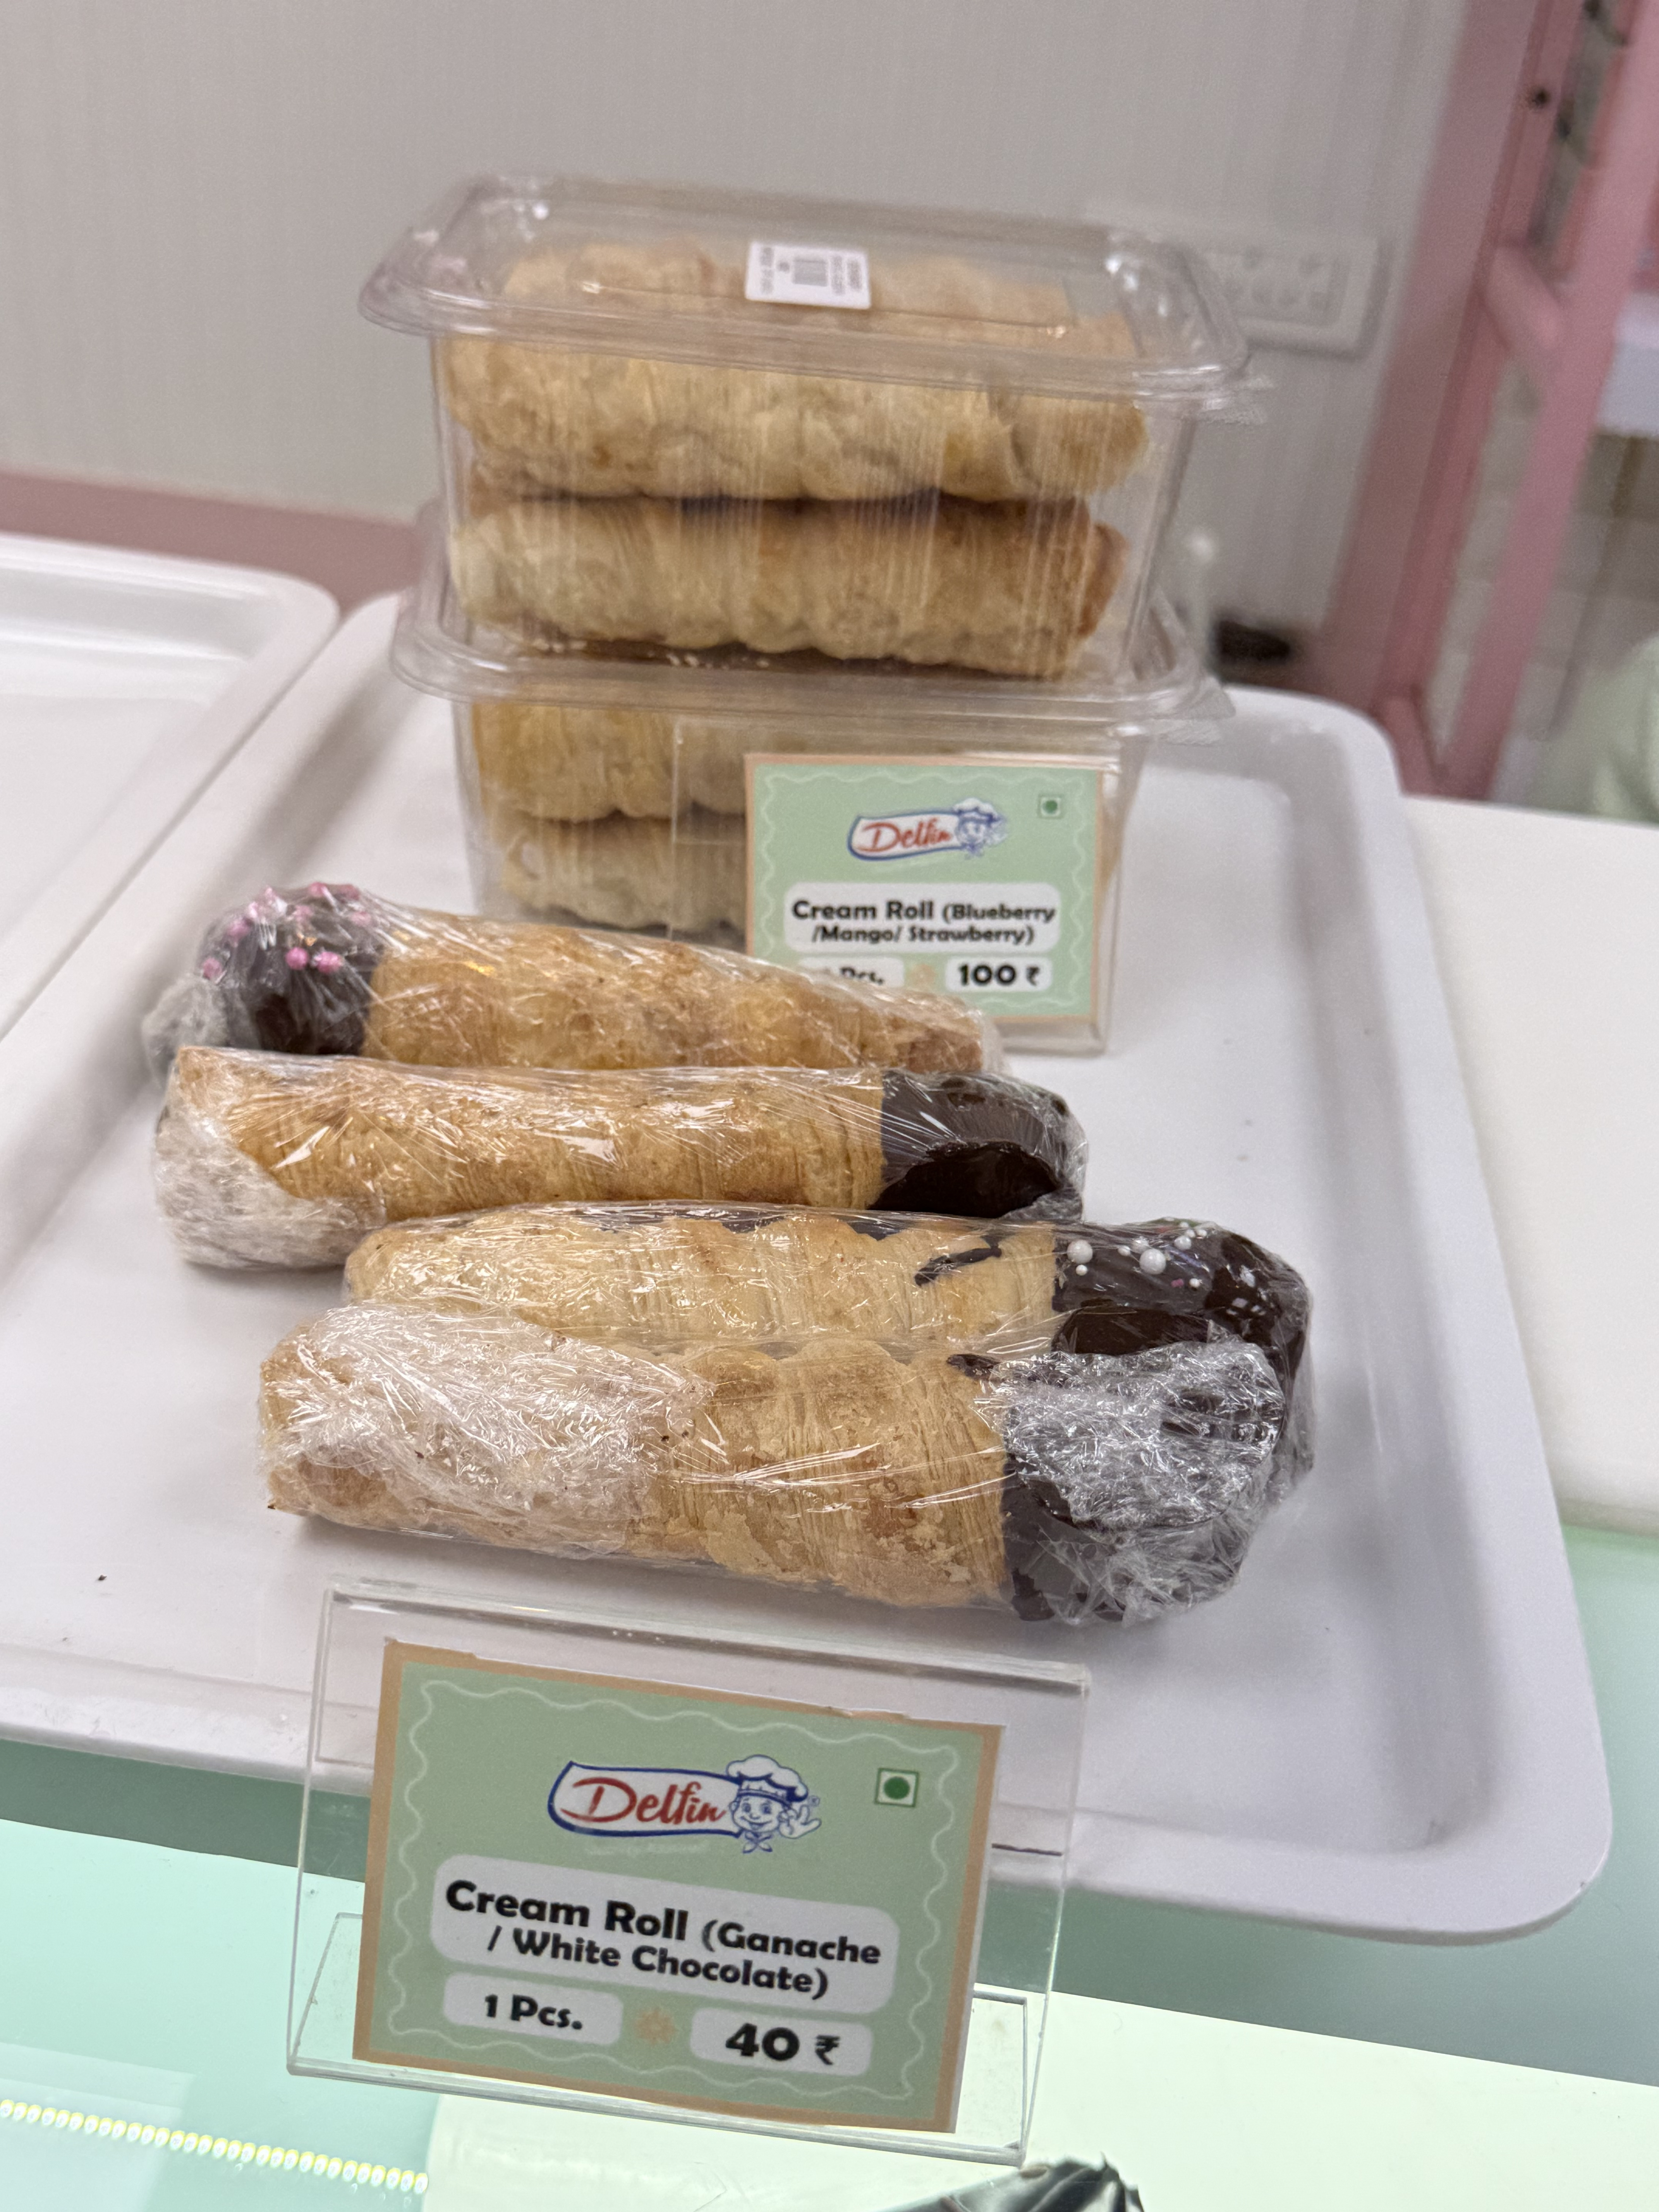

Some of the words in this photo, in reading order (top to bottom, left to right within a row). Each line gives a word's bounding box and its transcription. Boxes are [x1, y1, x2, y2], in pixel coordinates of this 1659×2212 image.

[854, 817, 952, 852] Delfin
[792, 900, 877, 920] Cream
[886, 900, 934, 920] Roll
[942, 903, 1055, 923] (Blueberry
[909, 925, 1034, 945] Strawberry)
[959, 964, 1017, 986] 100
[1026, 966, 1040, 986] ₹
[560, 1777, 726, 1825] Delfin
[446, 1880, 590, 1927] Cream
[605, 1900, 689, 1941] Roll
[702, 1920, 881, 1964] (Ganache
[513, 1928, 621, 1967] White
[632, 1945, 828, 2000] Chocolate)
[485, 1994, 498, 2018] 1
[510, 1994, 582, 2030] Pcs.
[725, 2023, 800, 2062] 40
[815, 2035, 840, 2065] ₹
